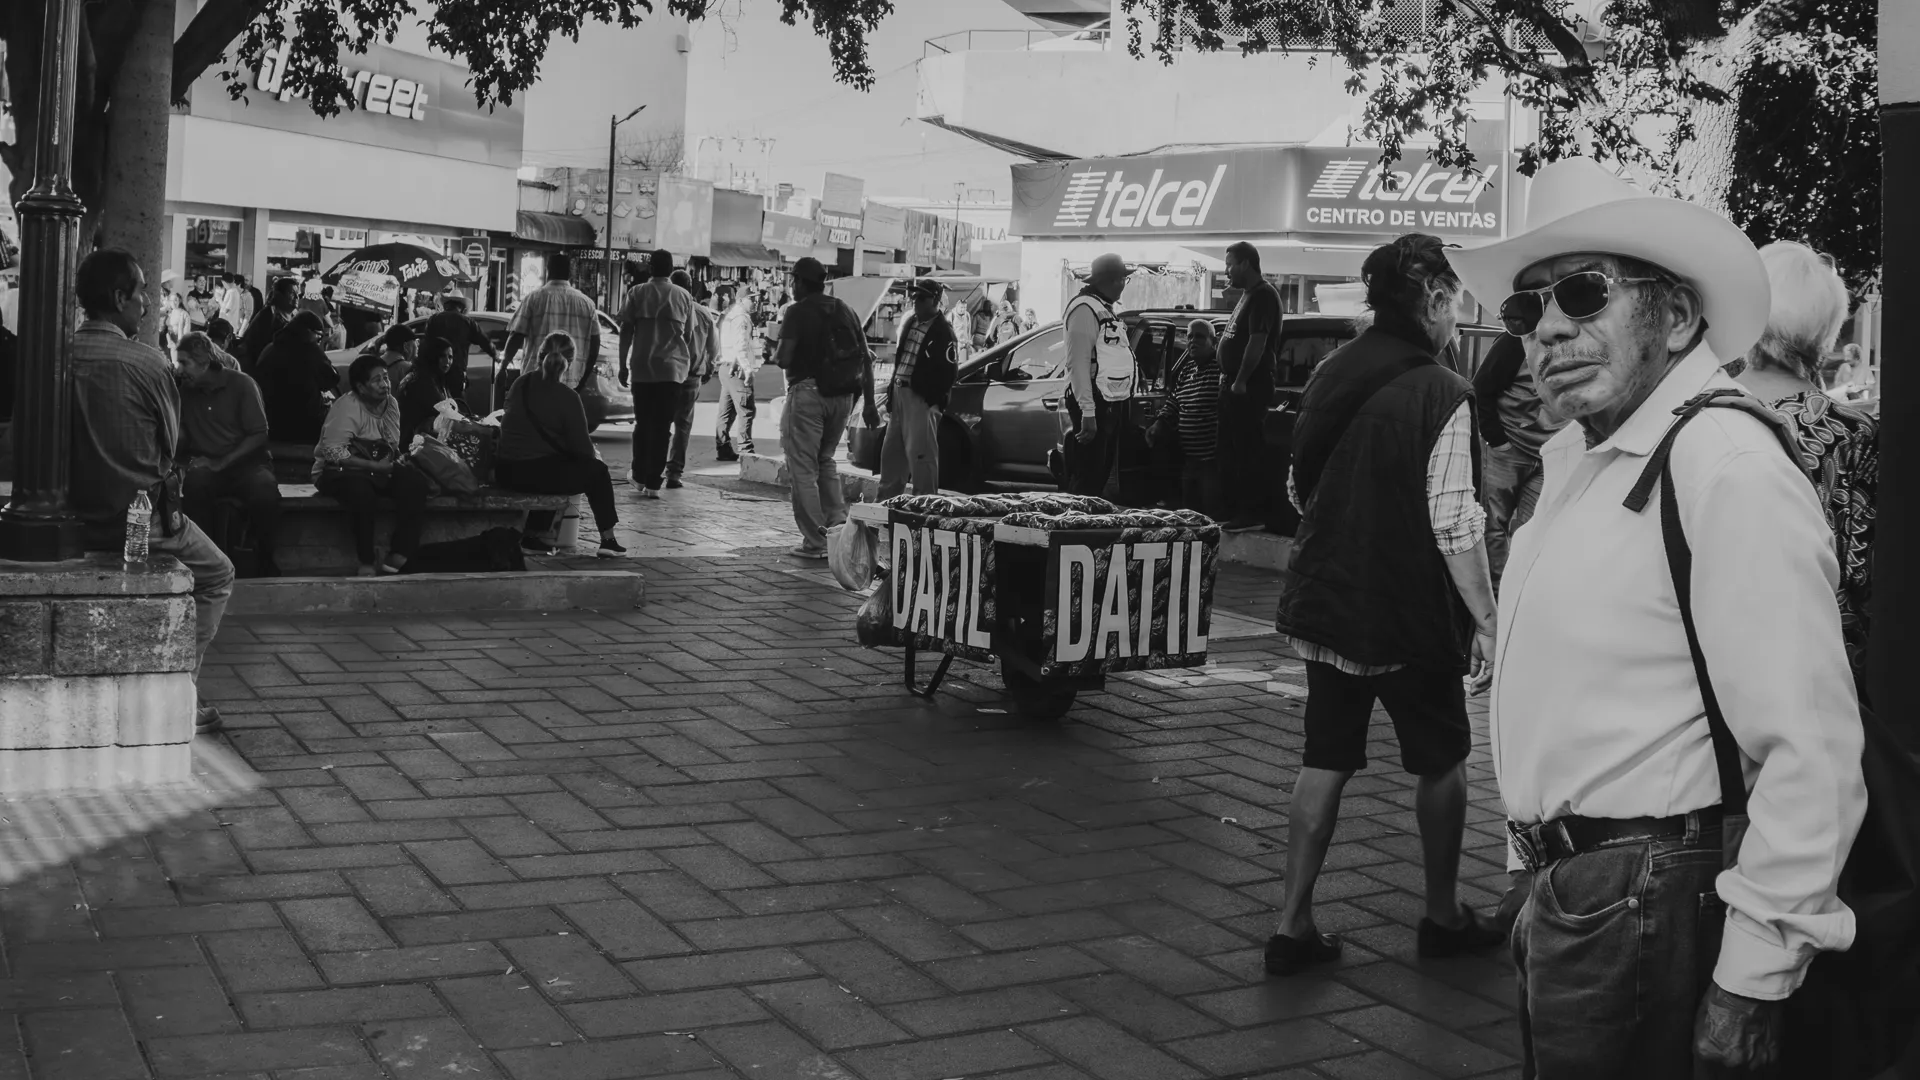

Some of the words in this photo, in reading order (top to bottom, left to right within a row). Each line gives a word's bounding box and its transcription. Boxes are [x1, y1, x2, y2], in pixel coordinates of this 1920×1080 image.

[1097, 164, 1227, 228] telcel
[1358, 162, 1498, 204] telcel
[1306, 207, 1385, 226] CENTRO
[1390, 209, 1416, 226] DE
[1420, 211, 1497, 229] VENTAS
[345, 278, 385, 293] Gorditas
[399, 257, 429, 282] Takis
[892, 522, 991, 650] DATIL
[1055, 540, 1208, 663] DATIL
